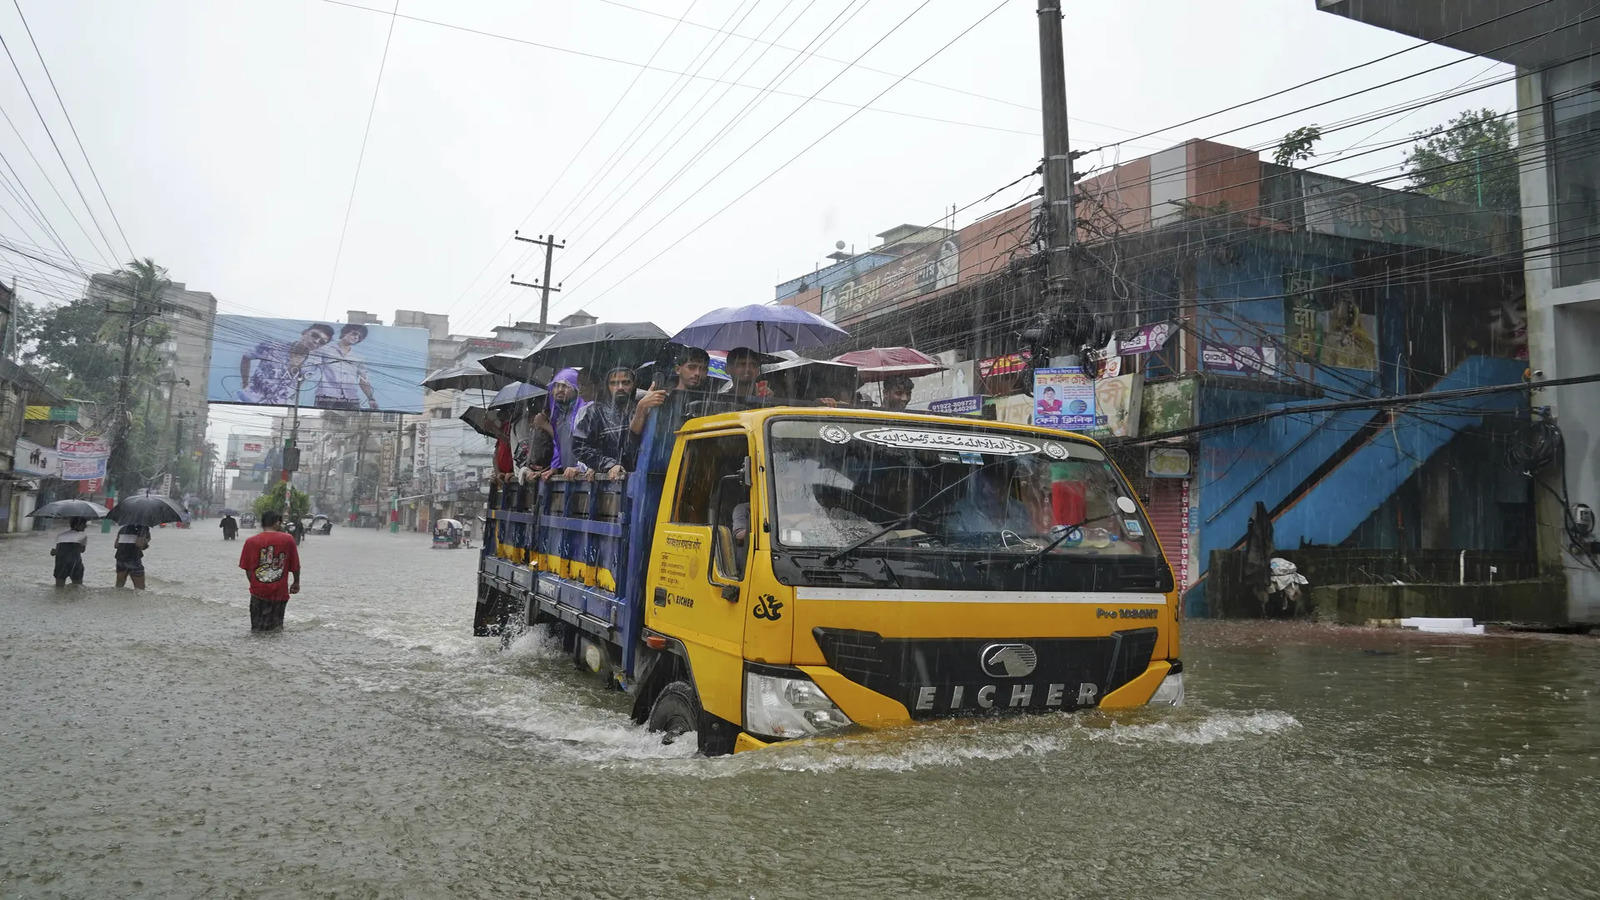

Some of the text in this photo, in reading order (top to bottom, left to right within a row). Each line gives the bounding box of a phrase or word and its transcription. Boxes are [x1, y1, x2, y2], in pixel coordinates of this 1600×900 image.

[1062, 415, 1093, 425] ক্লিনিক
[675, 595, 694, 608] EICHER
[1096, 608, 1117, 619] Pro
[915, 682, 1099, 711] EICHER
